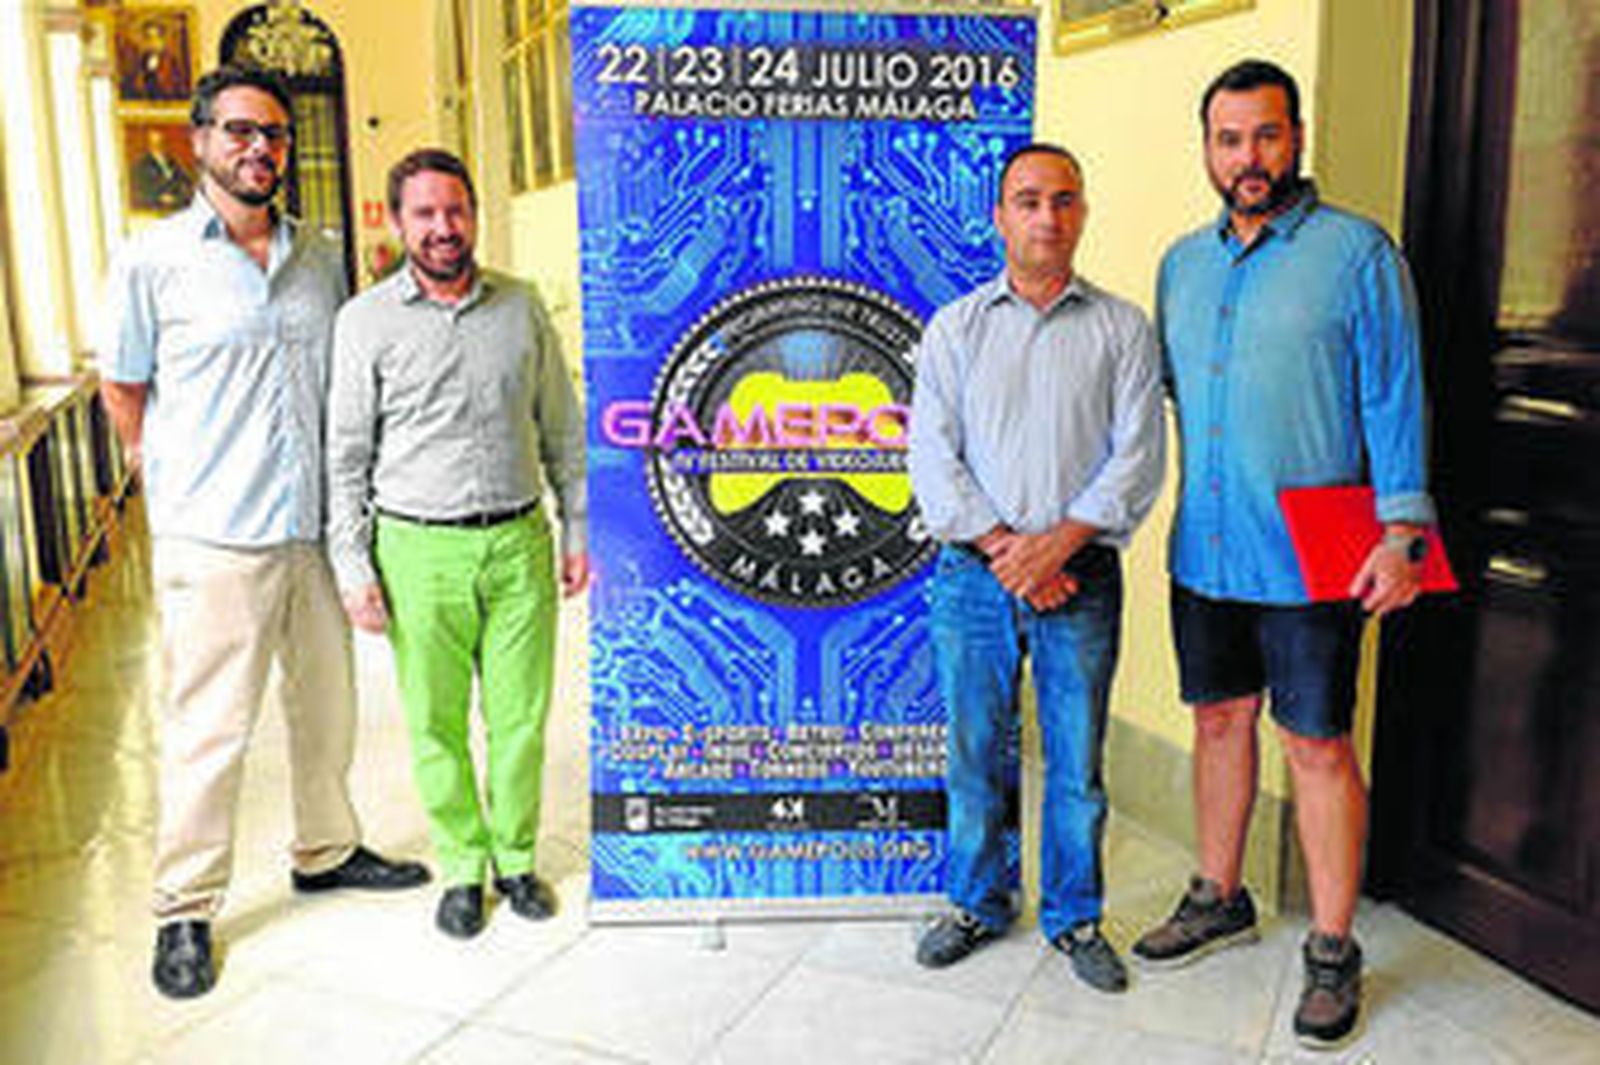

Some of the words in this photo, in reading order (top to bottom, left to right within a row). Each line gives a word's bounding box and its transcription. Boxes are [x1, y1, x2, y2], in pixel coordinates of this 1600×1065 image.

[811, 53, 918, 89] JULIO
[929, 56, 1020, 90] 2016
[634, 91, 757, 116] PALACIO
[763, 93, 848, 117] FERIAS
[854, 91, 976, 119] MÁLAGA
[729, 555, 892, 596] MÁLAGA
